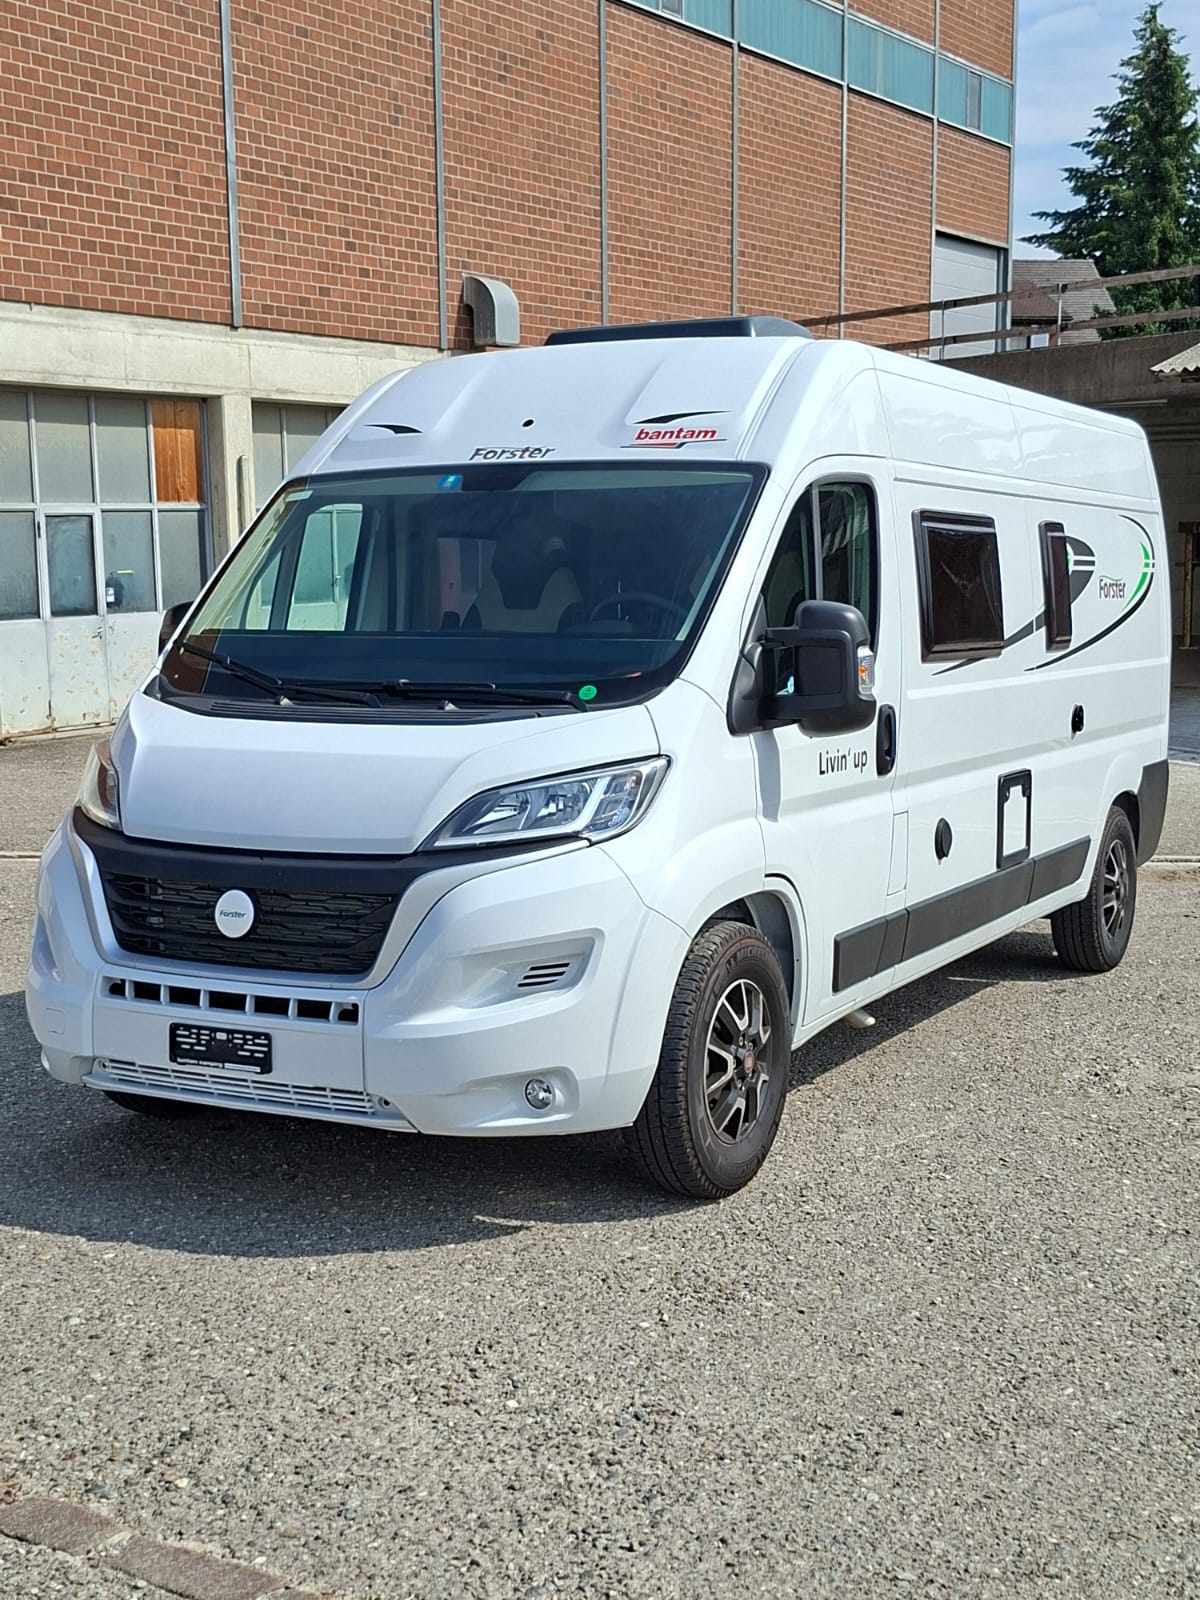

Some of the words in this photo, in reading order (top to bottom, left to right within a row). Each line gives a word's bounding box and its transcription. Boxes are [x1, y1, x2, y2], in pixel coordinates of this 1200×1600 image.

[635, 428, 716, 441] bantam
[470, 446, 555, 460] Forster
[1098, 579, 1126, 599] Forster
[854, 750, 868, 774] up
[219, 909, 247, 919] Forster
